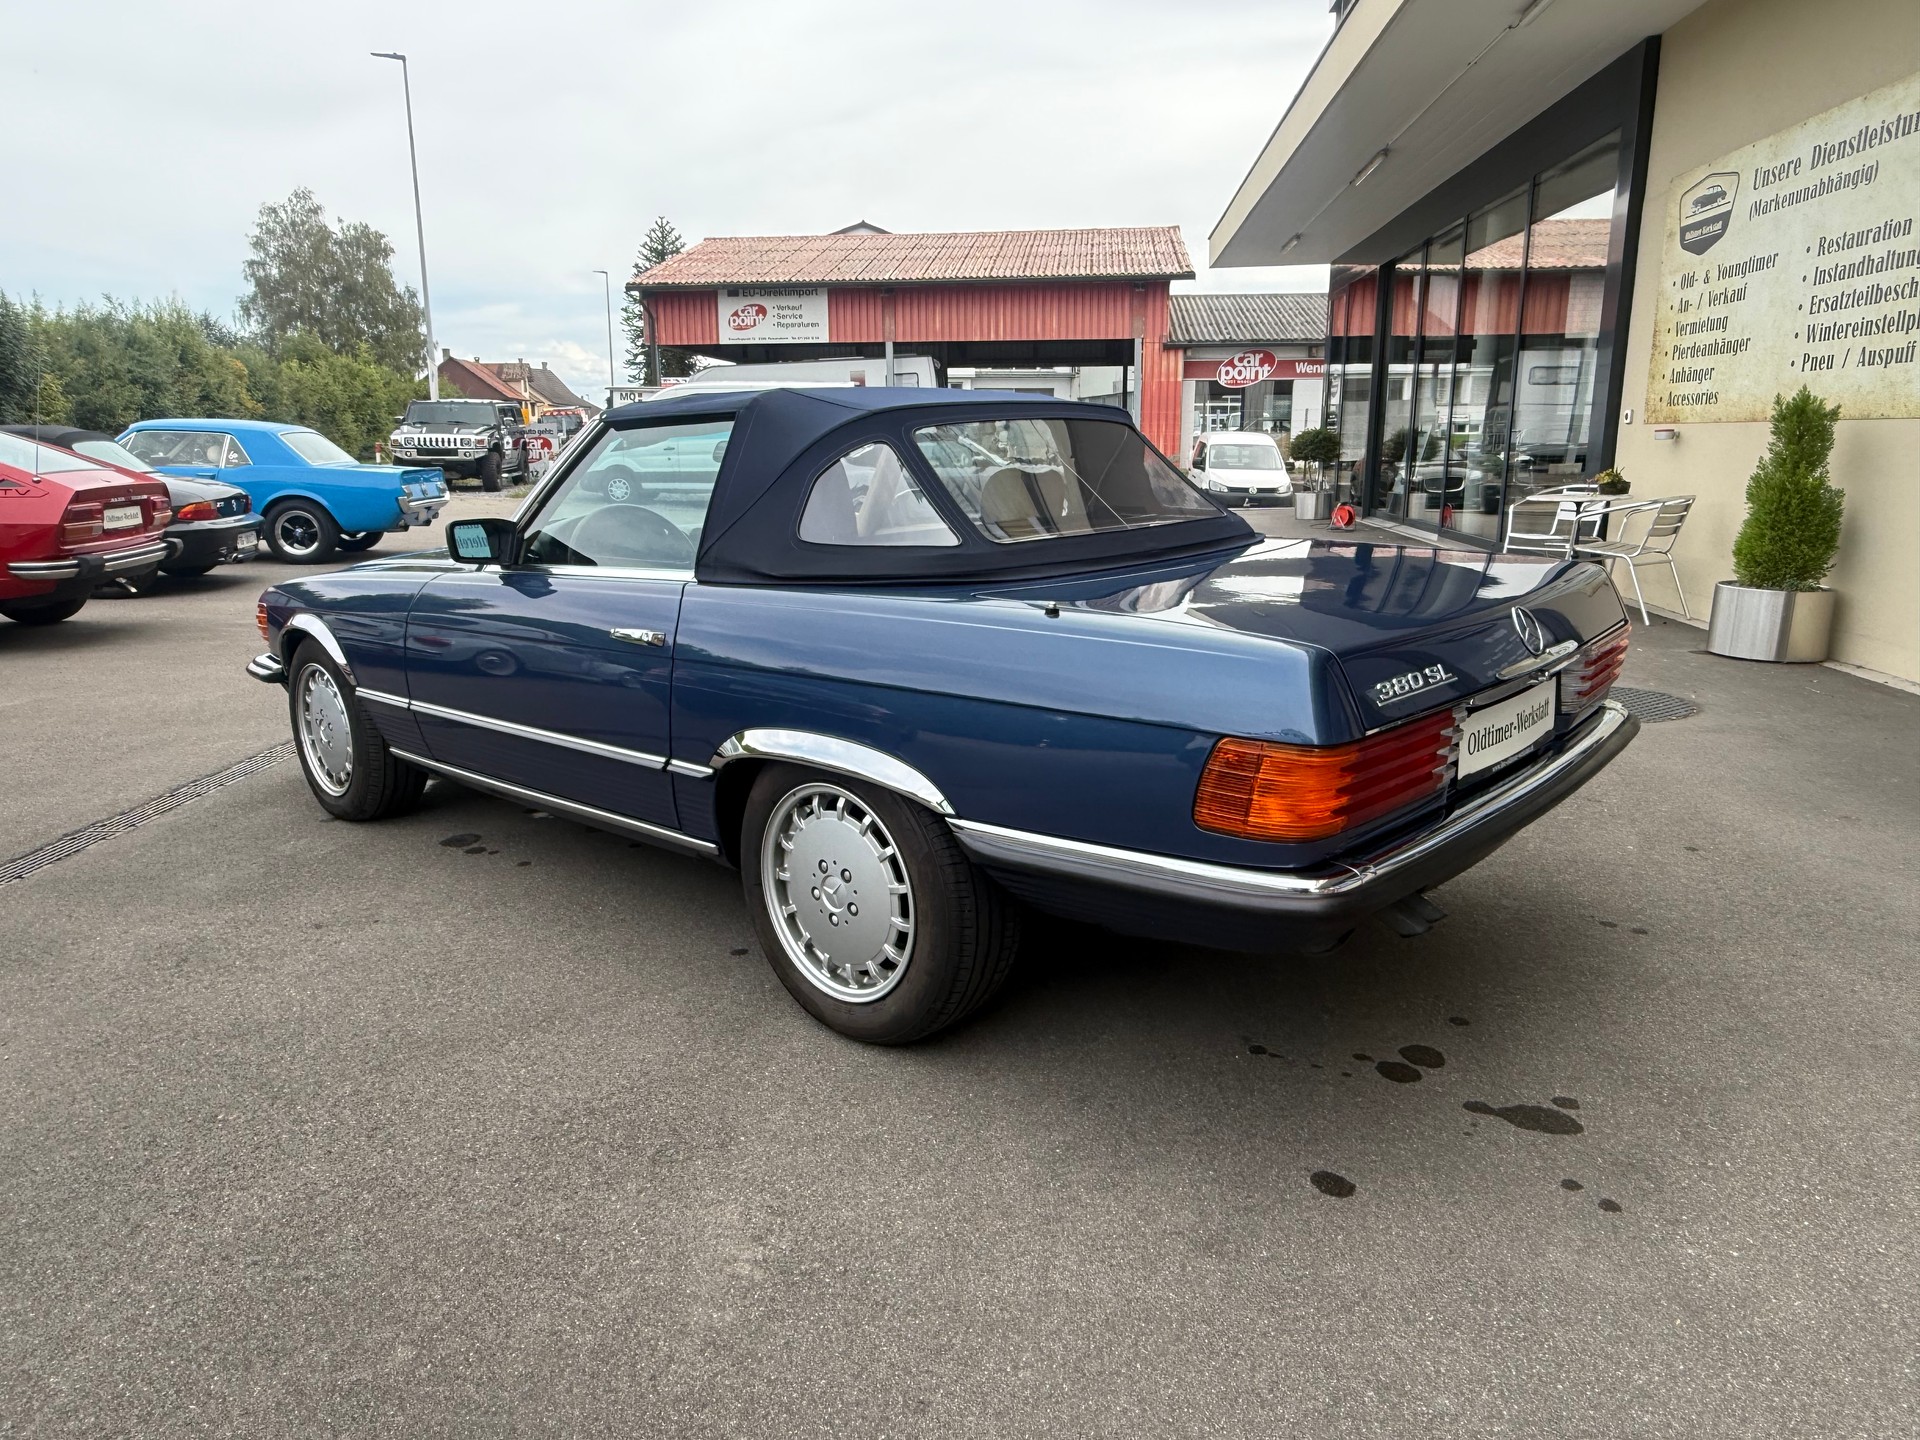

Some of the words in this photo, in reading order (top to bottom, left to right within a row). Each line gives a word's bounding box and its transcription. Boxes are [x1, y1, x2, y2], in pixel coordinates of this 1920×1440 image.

[1753, 156, 1802, 191] Unsere
[1749, 160, 1880, 221] (Markenunabhängig)
[1817, 218, 1913, 257] Restauration
[1680, 271, 1698, 290] Old-
[1703, 269, 1710, 284] &
[1717, 253, 1779, 281] Youngtimer
[742, 288, 818, 298] EU-Direktimport
[1678, 298, 1693, 313] An-
[1697, 293, 1703, 310] /
[1708, 282, 1748, 307] Verkauf
[730, 314, 764, 327] point
[738, 305, 758, 316] car
[776, 322, 820, 330] Reparaturen
[1675, 316, 1729, 337] Vermietung
[1233, 352, 1264, 367] car
[1672, 338, 1751, 360] Pferdeanhänger
[1801, 353, 1835, 372] Pneu
[1842, 347, 1850, 369] /
[1857, 341, 1917, 369] Auspuff
[1221, 363, 1271, 382] point
[1669, 366, 1715, 384] Anhänger
[1666, 389, 1719, 407] Accessories
[1375, 671, 1424, 700] 380
[1423, 663, 1453, 685] SL
[1467, 696, 1550, 756] Oldtimer-Werkstatt
